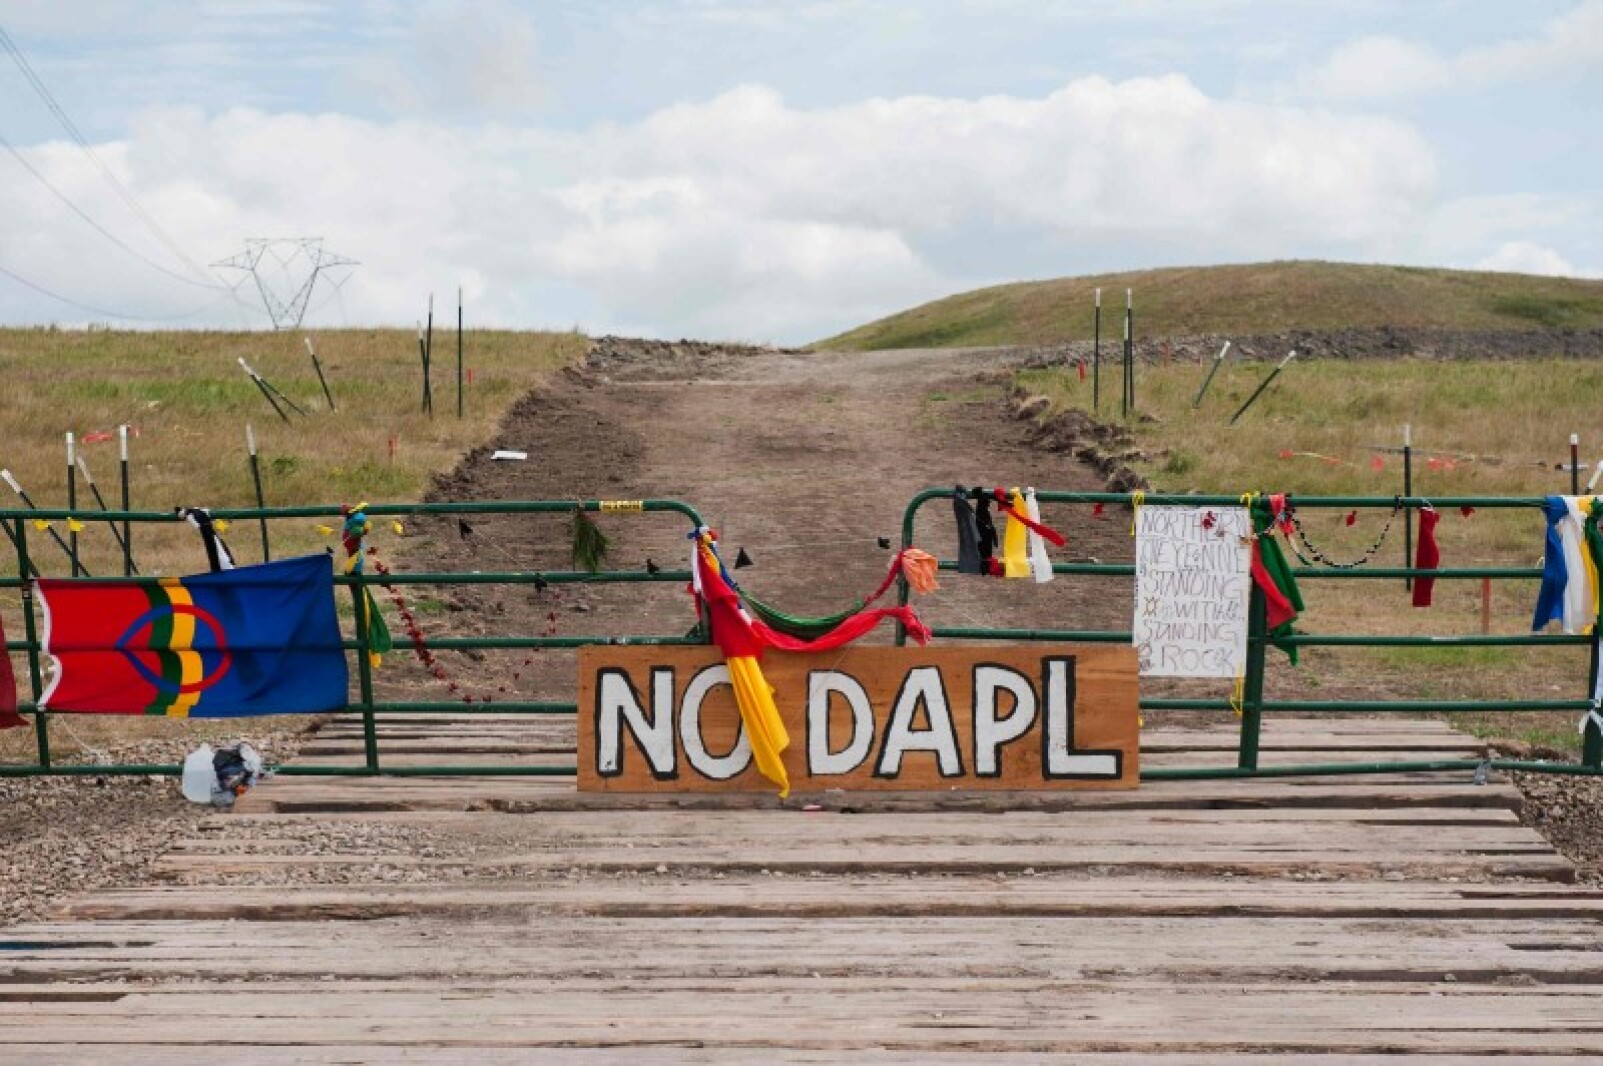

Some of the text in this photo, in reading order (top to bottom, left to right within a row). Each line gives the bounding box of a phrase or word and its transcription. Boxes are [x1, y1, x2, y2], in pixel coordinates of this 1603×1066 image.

[1144, 569, 1242, 602] STANDING
[1174, 600, 1226, 620] WITH
[1144, 619, 1238, 644] STANDING
[1162, 645, 1235, 677] ROCK
[596, 656, 1122, 779] NO DAPL
